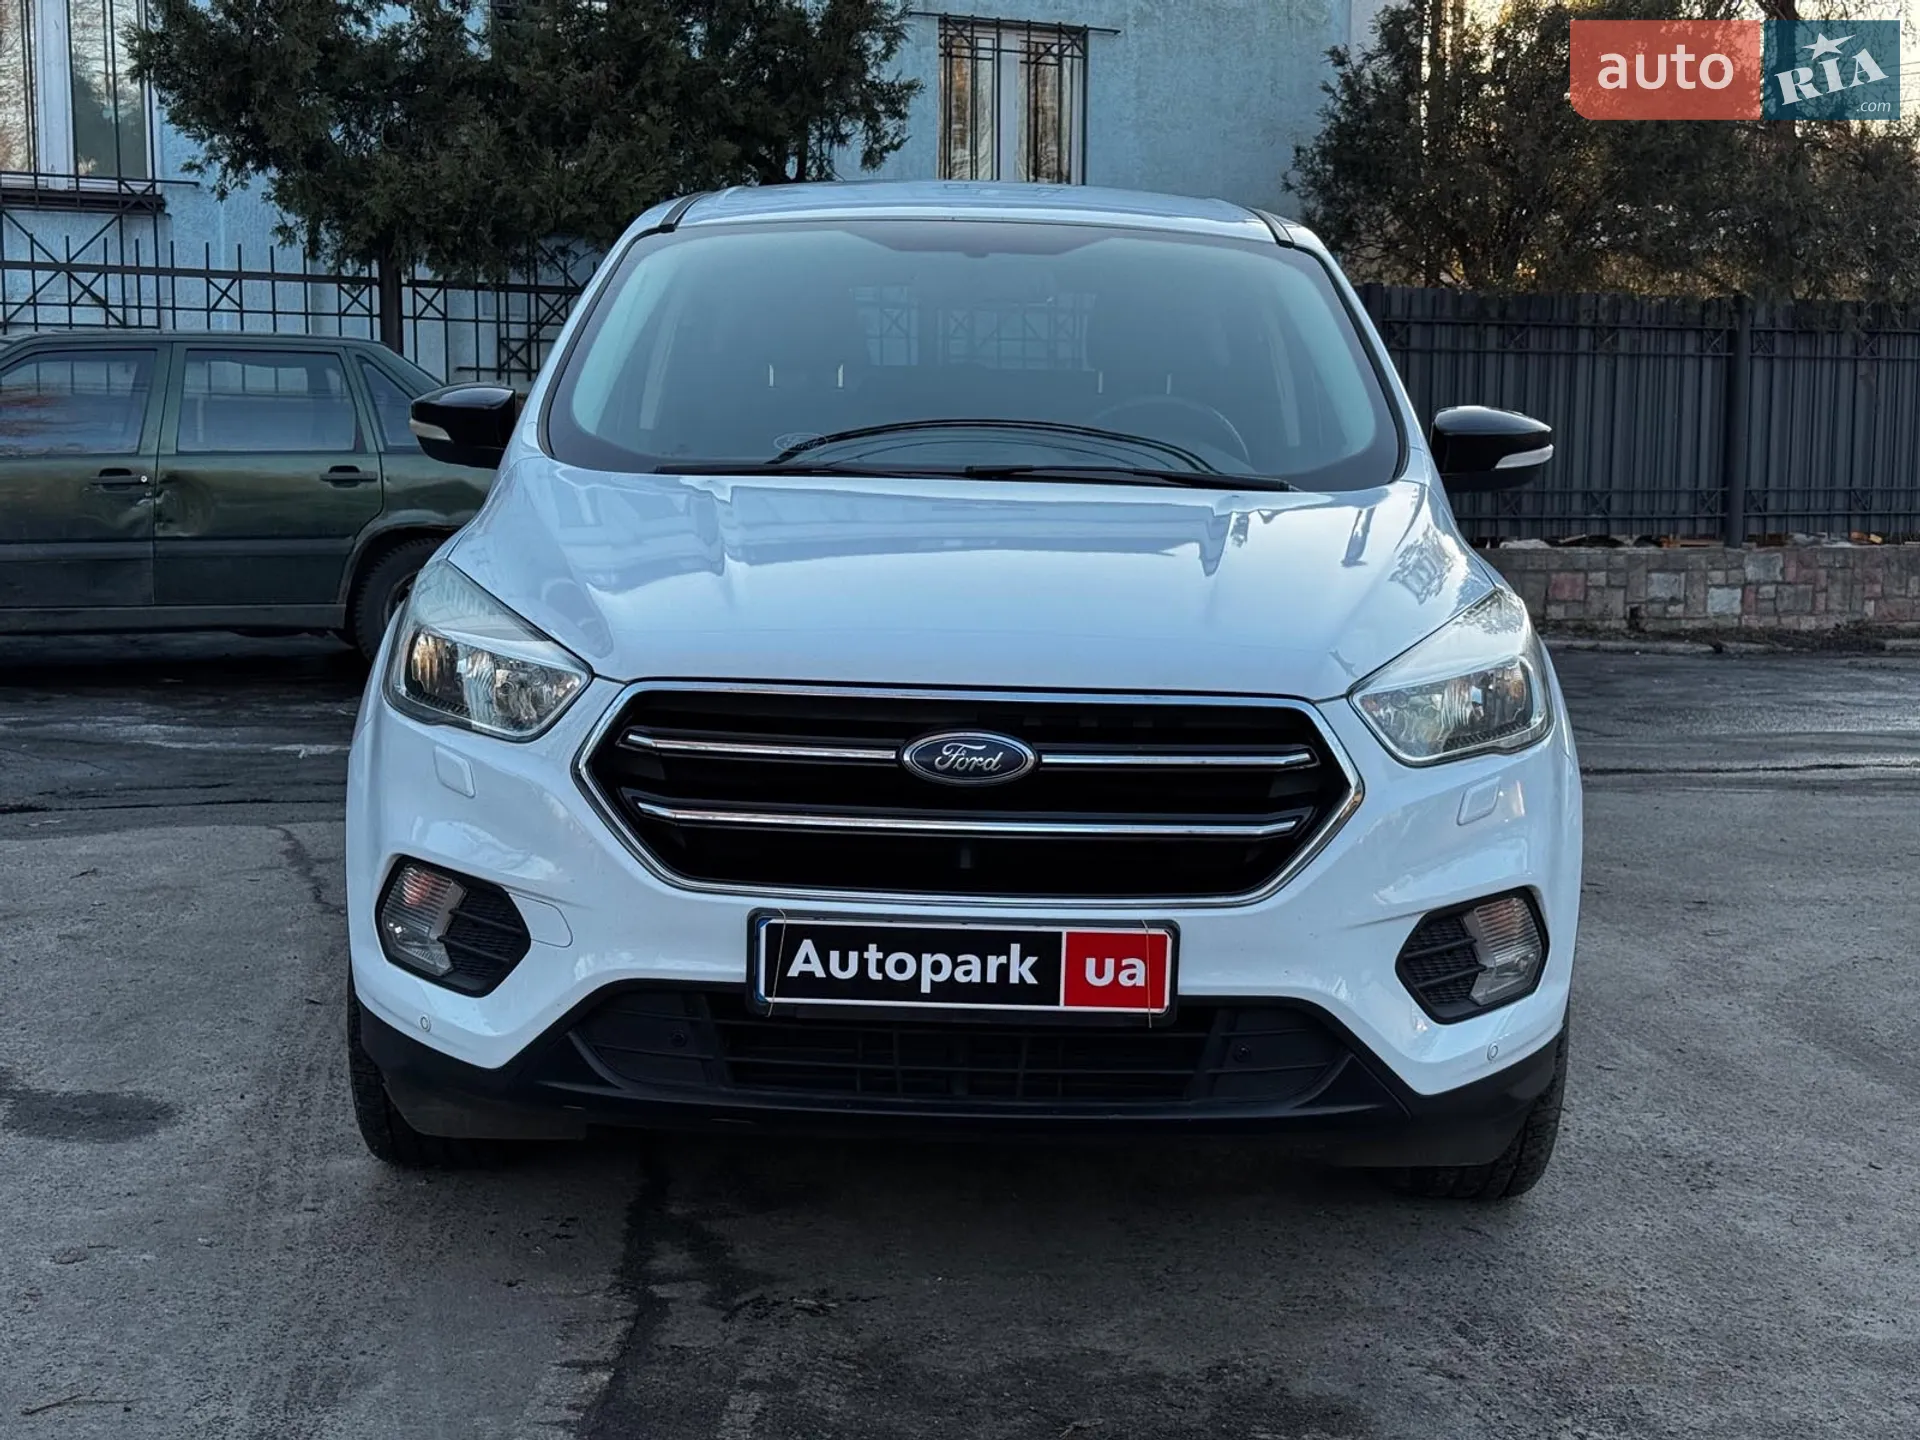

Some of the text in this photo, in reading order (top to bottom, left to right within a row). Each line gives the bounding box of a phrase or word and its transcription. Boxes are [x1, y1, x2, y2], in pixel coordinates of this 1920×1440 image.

[934, 742, 1003, 772] Ford
[787, 939, 1146, 993] Autopark ua
